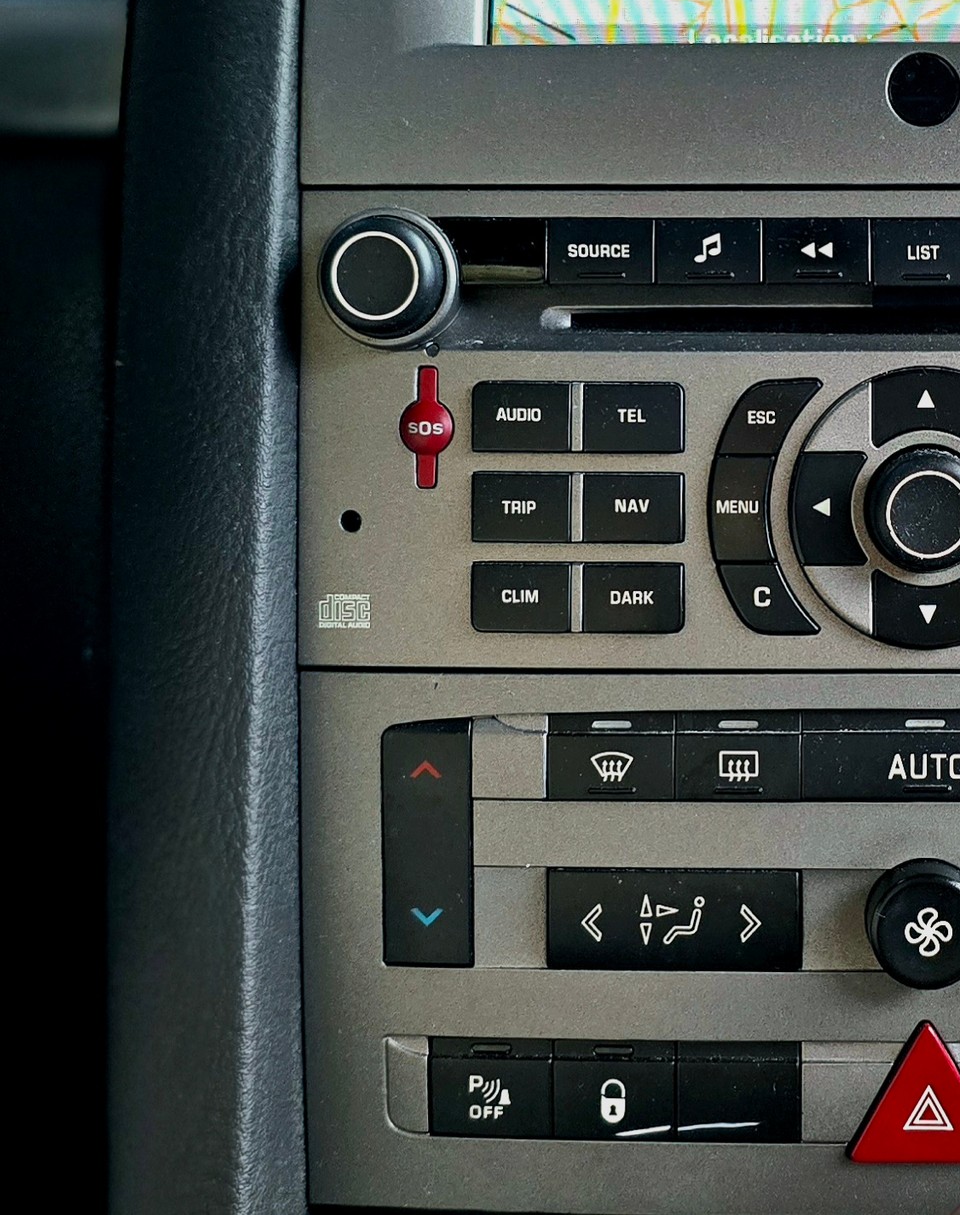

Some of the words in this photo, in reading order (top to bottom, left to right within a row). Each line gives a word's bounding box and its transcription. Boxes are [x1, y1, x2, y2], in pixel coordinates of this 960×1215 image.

[567, 243, 630, 259] SOURCE
[907, 244, 940, 261] LIST
[495, 406, 542, 423] AUDIO
[617, 408, 647, 424] TEL
[747, 409, 776, 426] ESC
[407, 419, 444, 437] SOS
[501, 500, 537, 515] TRIP
[614, 498, 650, 514] NAV
[716, 499, 759, 515] MENU
[501, 589, 539, 605] CLIM
[610, 590, 654, 606] DARK
[753, 586, 771, 608] C
[468, 1104, 504, 1120] OFF
